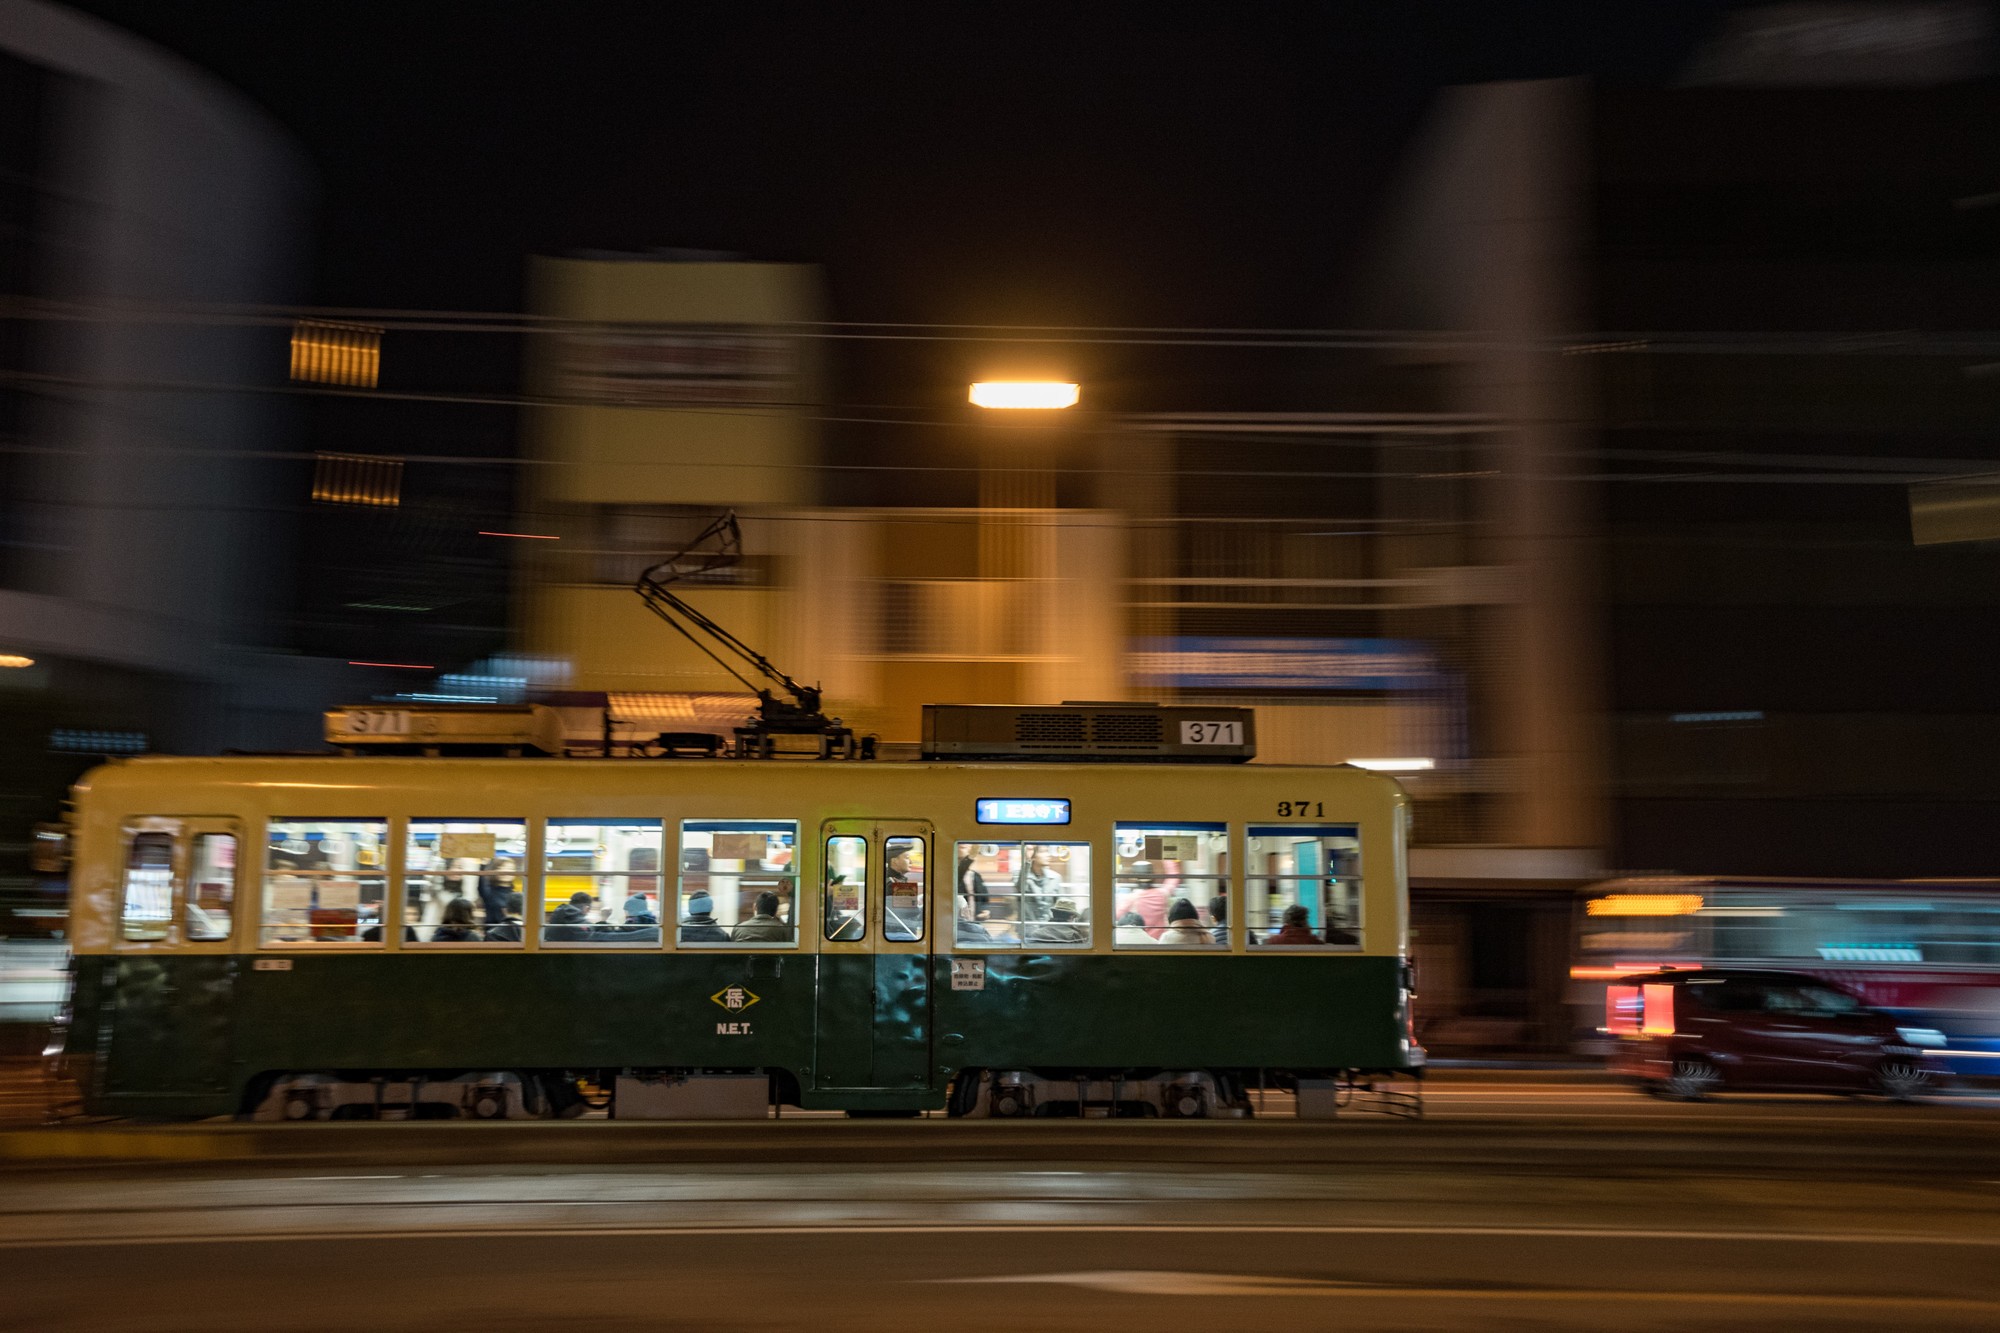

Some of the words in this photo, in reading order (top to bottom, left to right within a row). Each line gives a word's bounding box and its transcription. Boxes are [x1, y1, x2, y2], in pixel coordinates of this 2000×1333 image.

[1189, 723, 1235, 743] 371
[985, 802, 999, 820] 1
[1277, 801, 1325, 818] 371
[716, 1022, 754, 1035] N.E.T.
